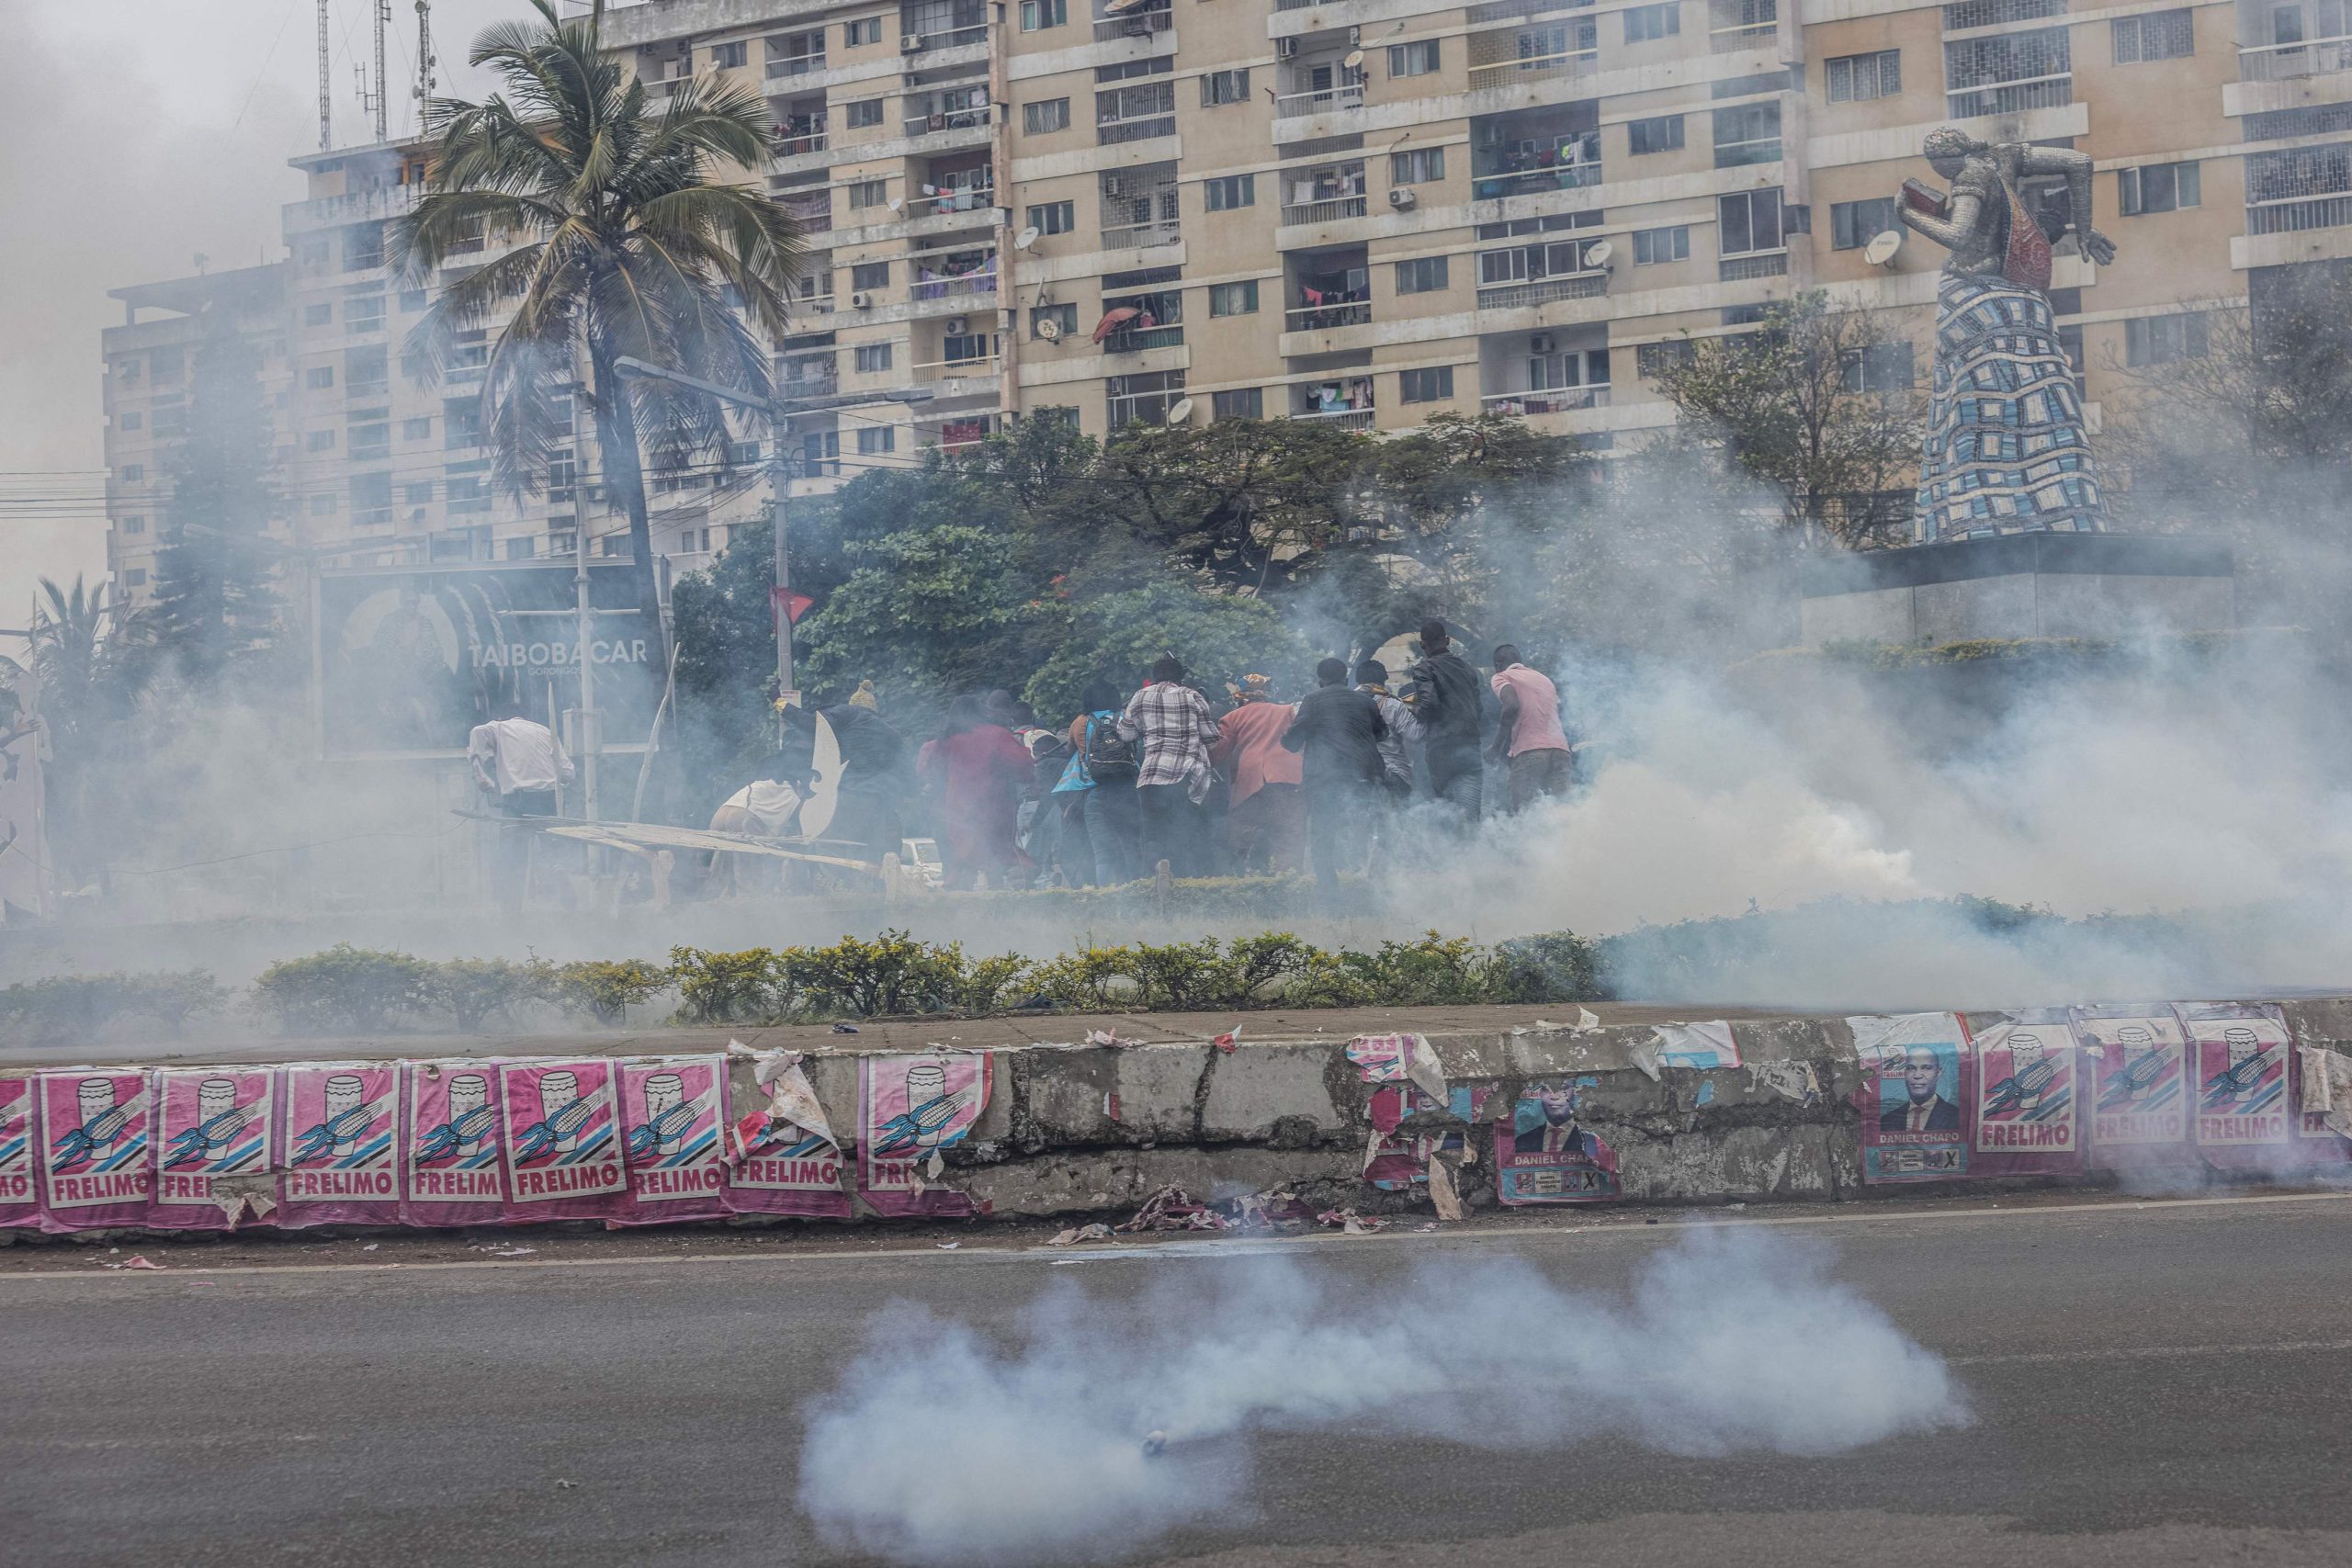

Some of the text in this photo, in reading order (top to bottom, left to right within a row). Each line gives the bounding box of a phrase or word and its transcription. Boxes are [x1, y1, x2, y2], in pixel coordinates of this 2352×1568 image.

[1880, 1133, 1960, 1144] DANIEL CHAPO
[1982, 1123, 2070, 1146] FRELIMO
[2199, 1116, 2285, 1140] FRELIMO
[736, 1160, 838, 1184] FRELIMO
[1515, 1156, 1556, 1166] DANIEL
[53, 1172, 148, 1201] FRELIMO
[292, 1172, 392, 1194] FRELIMO
[415, 1173, 498, 1194] FRELIM
[516, 1163, 618, 1195] FRELIMO
[634, 1168, 720, 1194] RELIMO
